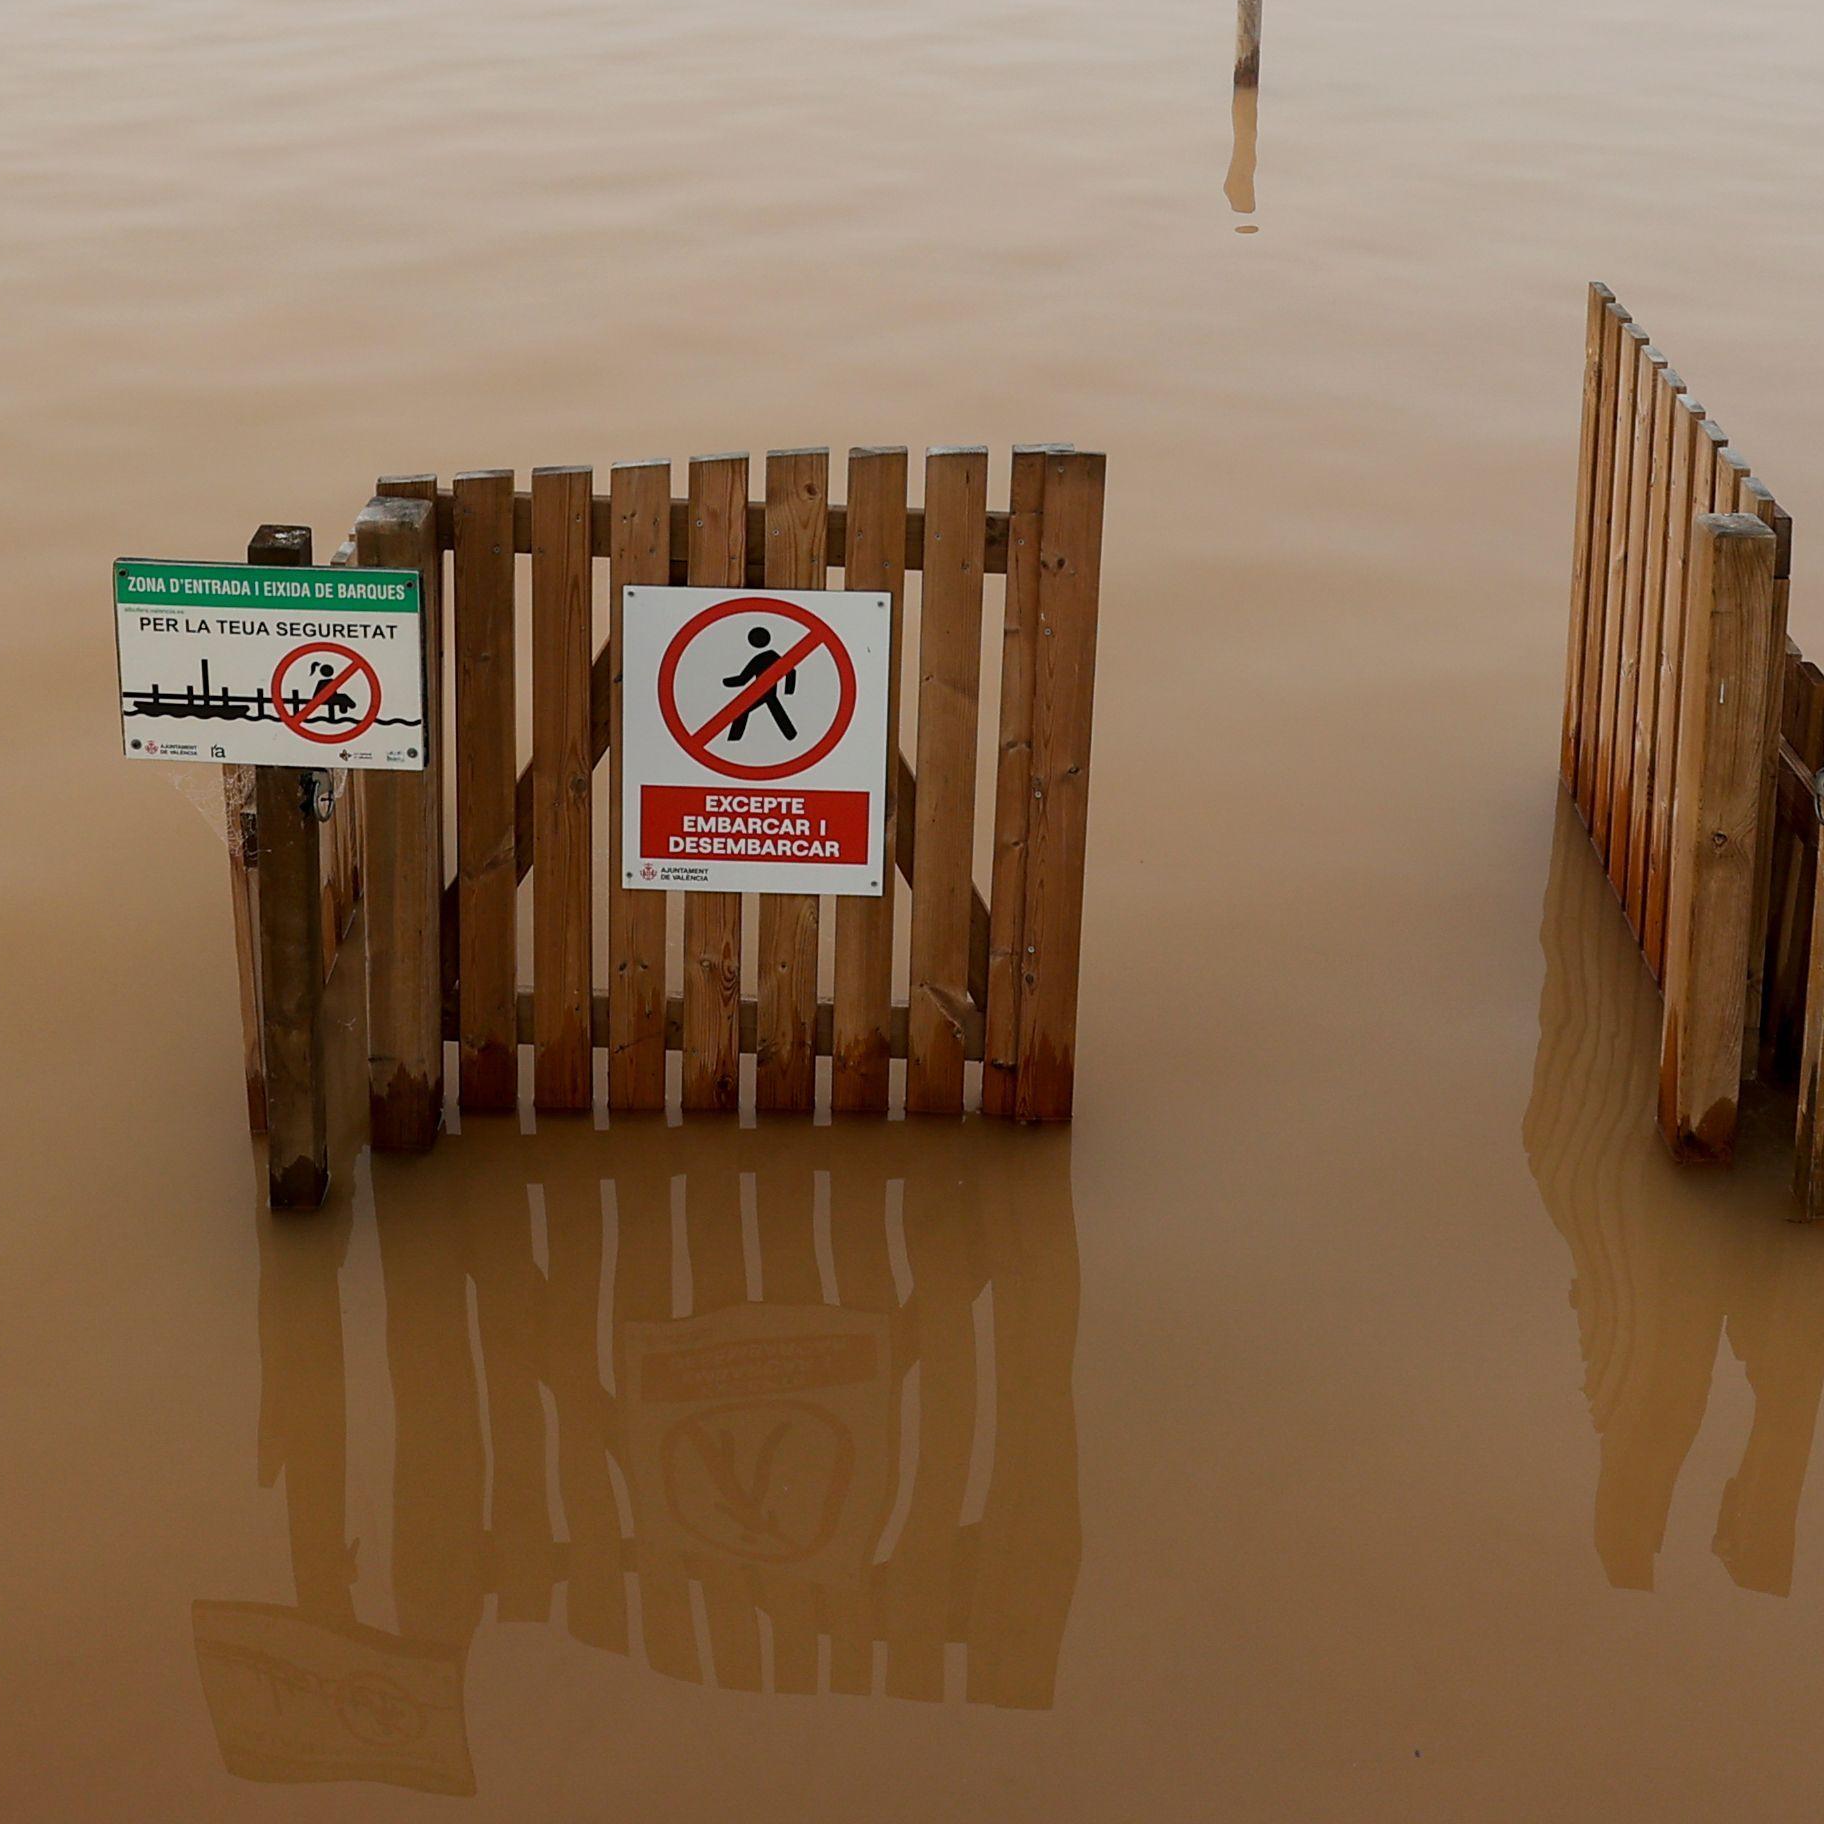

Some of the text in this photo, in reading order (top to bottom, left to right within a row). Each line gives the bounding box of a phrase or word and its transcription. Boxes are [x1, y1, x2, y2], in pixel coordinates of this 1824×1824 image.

[127, 576, 406, 601] ZONA D'ENTRADA I EIXIDA DE BARQUES
[139, 616, 398, 640] PER LA TEUA SEGURETAT
[705, 795, 805, 815] EXCEPTE
[682, 815, 827, 837] EMBARCAR I
[668, 835, 840, 858] DESEMBARCAR
[660, 866, 709, 875] AJUNTAMENT
